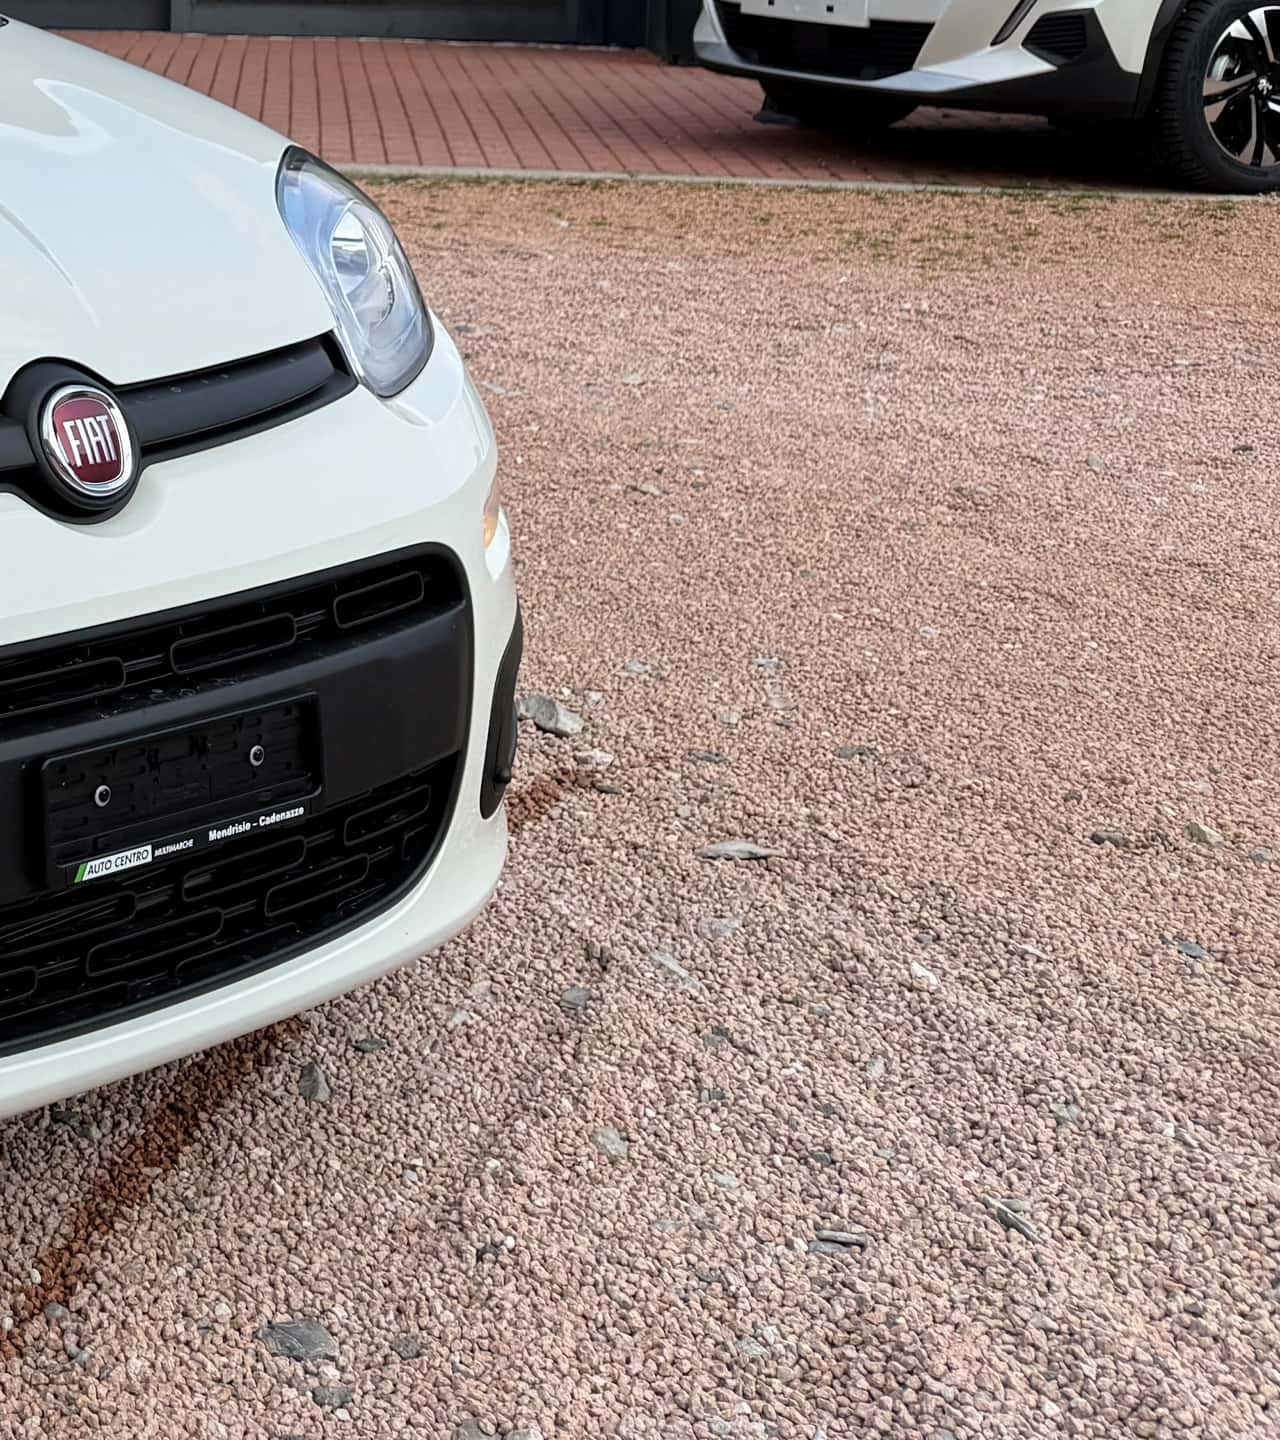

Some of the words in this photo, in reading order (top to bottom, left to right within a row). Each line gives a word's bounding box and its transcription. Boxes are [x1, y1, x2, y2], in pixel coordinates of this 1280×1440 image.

[62, 414, 117, 468] FIAT
[87, 859, 113, 877] AUTO
[113, 848, 150, 868] CENTRO
[208, 821, 251, 841] Mendrisio
[259, 806, 305, 827] Cadenazzo
